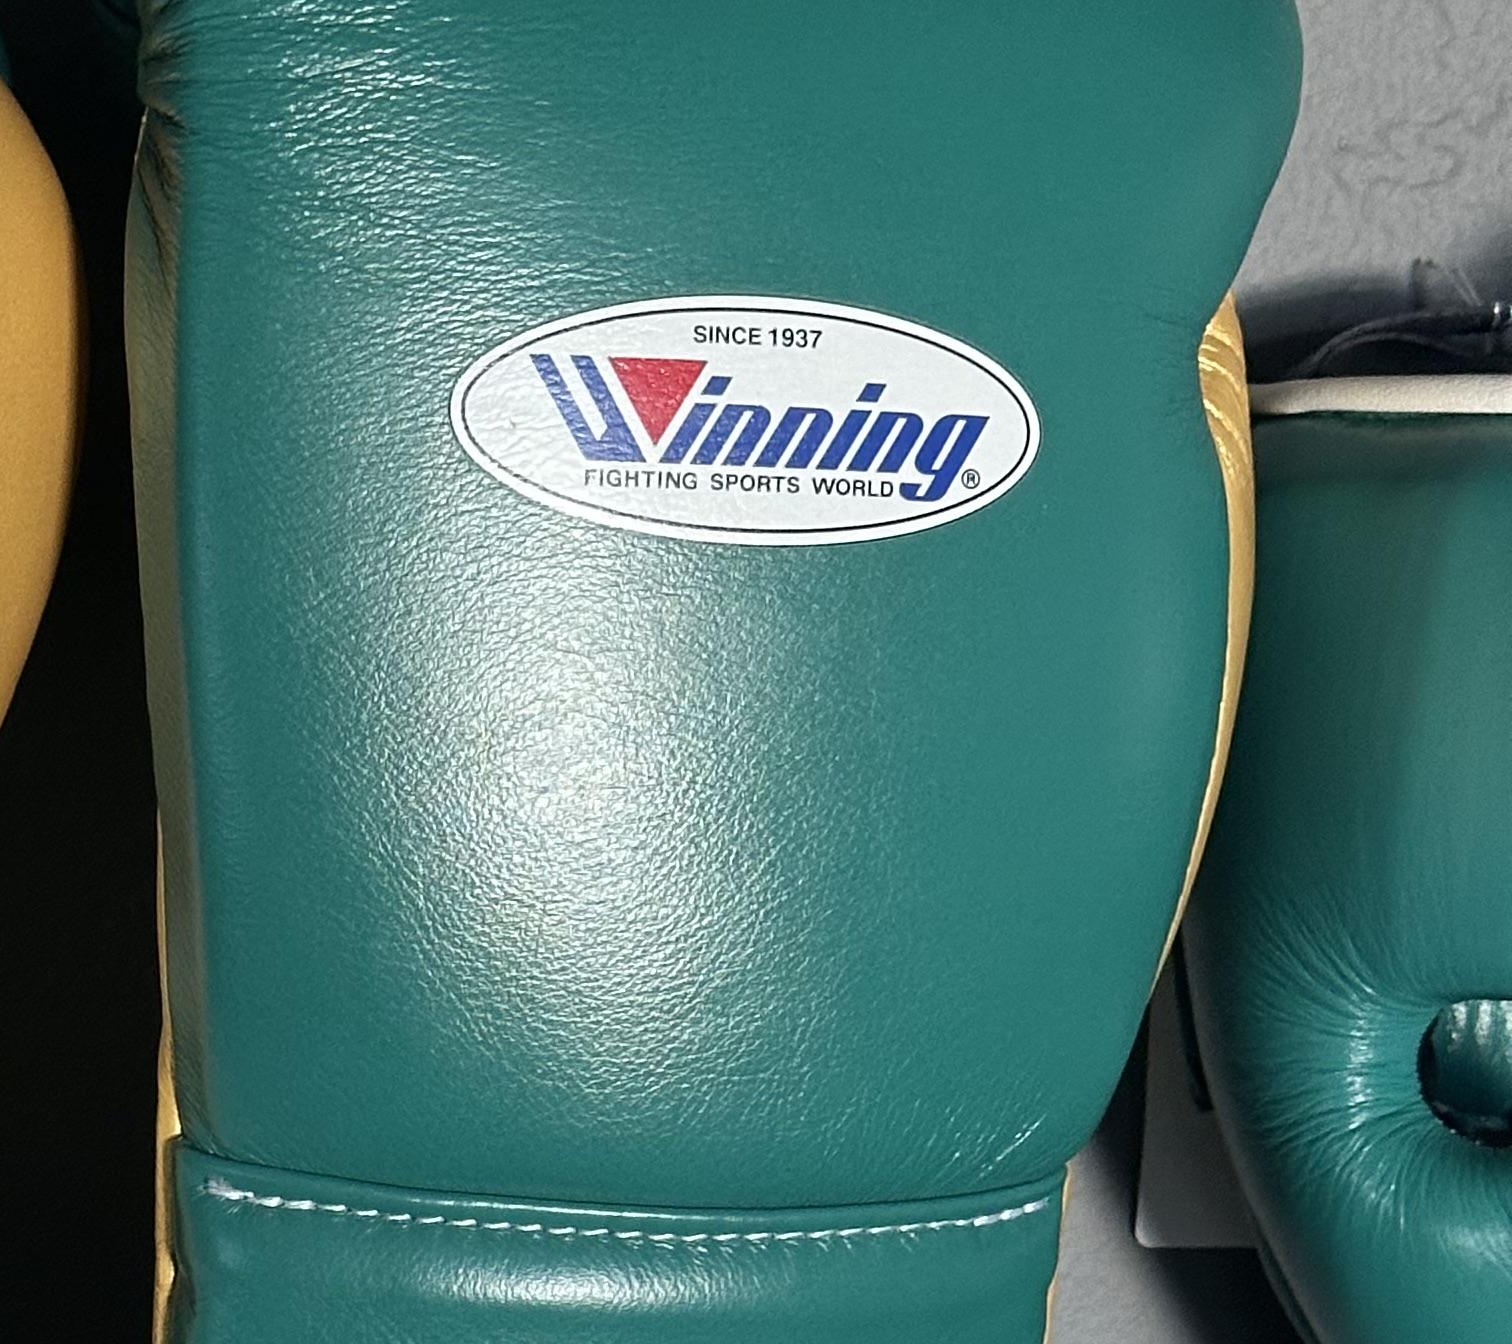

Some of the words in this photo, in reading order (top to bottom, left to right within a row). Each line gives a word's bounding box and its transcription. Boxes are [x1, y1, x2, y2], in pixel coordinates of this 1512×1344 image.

[693, 325, 762, 346] SINCE
[768, 328, 823, 349] 1937
[529, 353, 990, 502] Winning
[585, 469, 698, 490] FIGHTING
[711, 474, 800, 494] SPORTS
[813, 479, 894, 498] WORLD
